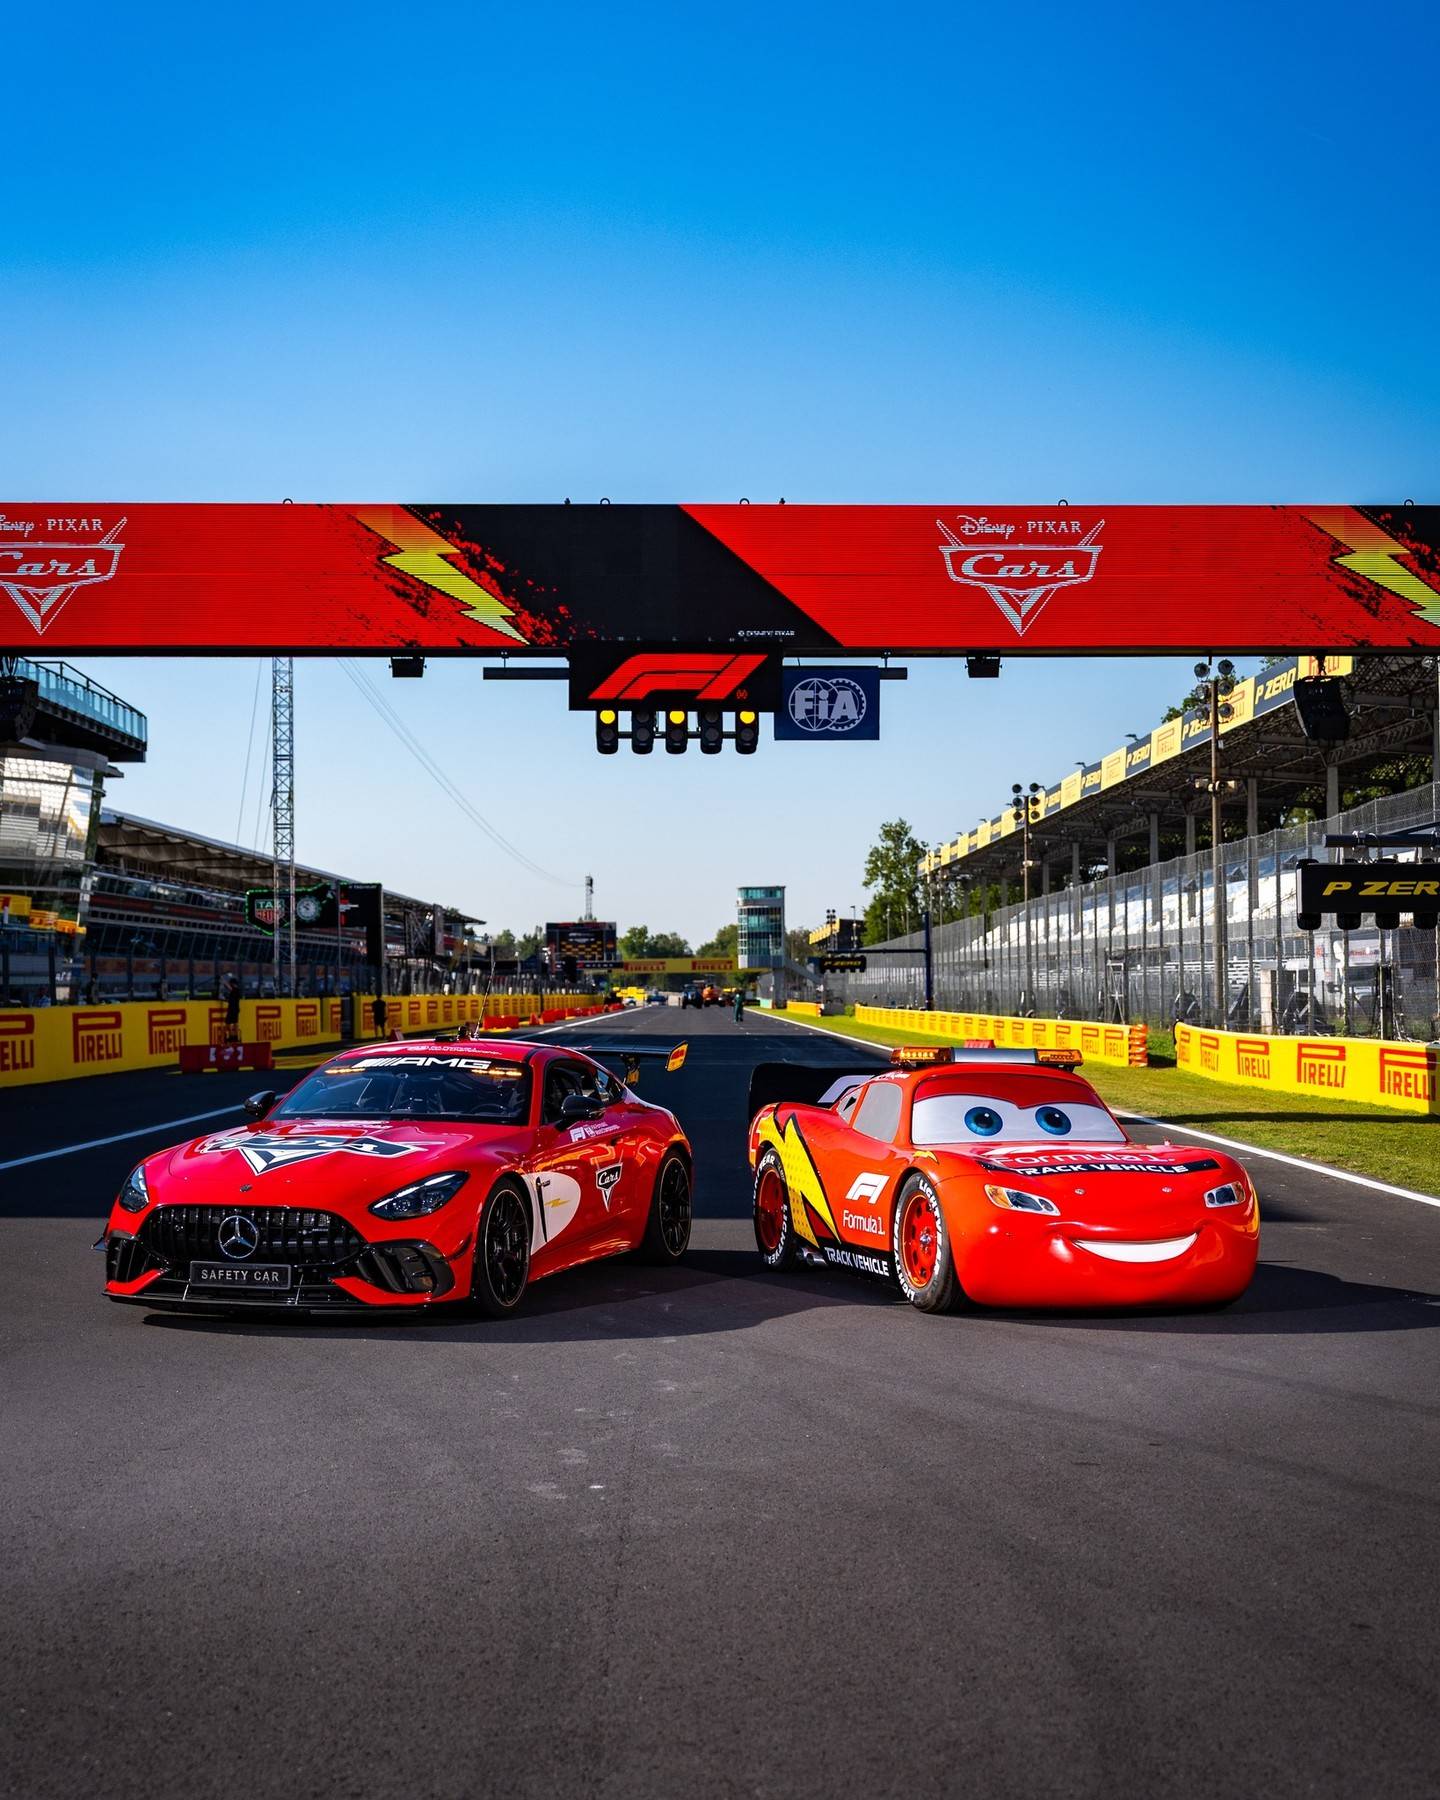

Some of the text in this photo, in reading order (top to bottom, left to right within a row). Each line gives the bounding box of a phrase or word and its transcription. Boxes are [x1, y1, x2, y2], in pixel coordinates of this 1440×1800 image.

[47, 519, 103, 531] PIXAR
[956, 515, 1082, 539] Disney PIXAR
[961, 553, 1080, 577] Cars
[1255, 667, 1297, 705] P ZERO
[1322, 881, 1440, 896] P ZER
[256, 1005, 282, 1041] PIRELLI
[72, 1011, 122, 1063] PIRELLI
[391, 1057, 491, 1070] AMG
[1236, 1039, 1270, 1080] PIRELLI
[1297, 1043, 1346, 1088] PIRELLI
[1379, 1047, 1437, 1102] PIRELLI
[1013, 1164, 1189, 1175] TRACK VEHICLE
[824, 1246, 890, 1277] TRACK VEHICLE
[201, 1269, 279, 1282] SAFETY CAR
